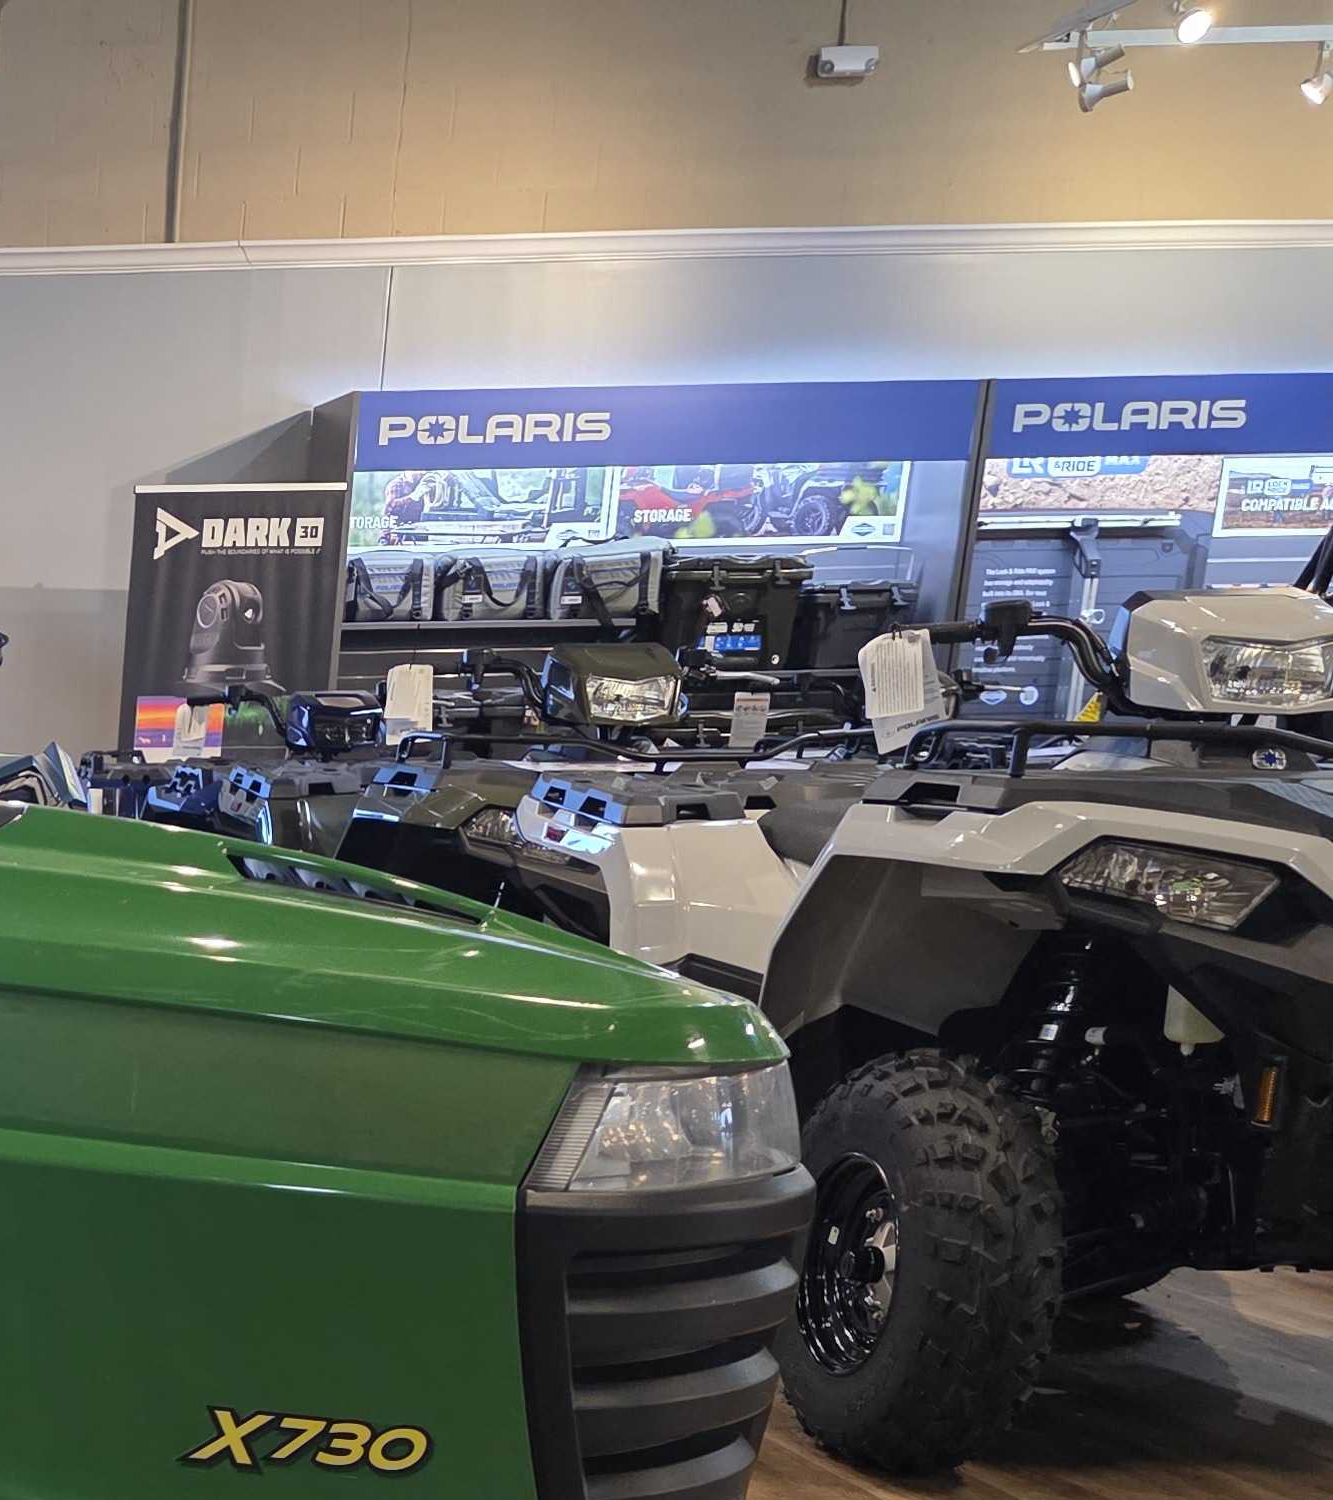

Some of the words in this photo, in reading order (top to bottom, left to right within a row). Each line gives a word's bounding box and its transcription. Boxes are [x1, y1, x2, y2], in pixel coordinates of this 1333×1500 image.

[378, 412, 611, 446] POLARIS
[1012, 399, 1247, 433] POLARIS
[633, 508, 693, 523] STORAGE
[1241, 497, 1319, 511] COMPATIBLE
[201, 517, 292, 548] DARK
[349, 515, 399, 529] TORAGE
[181, 1405, 432, 1474] X730
